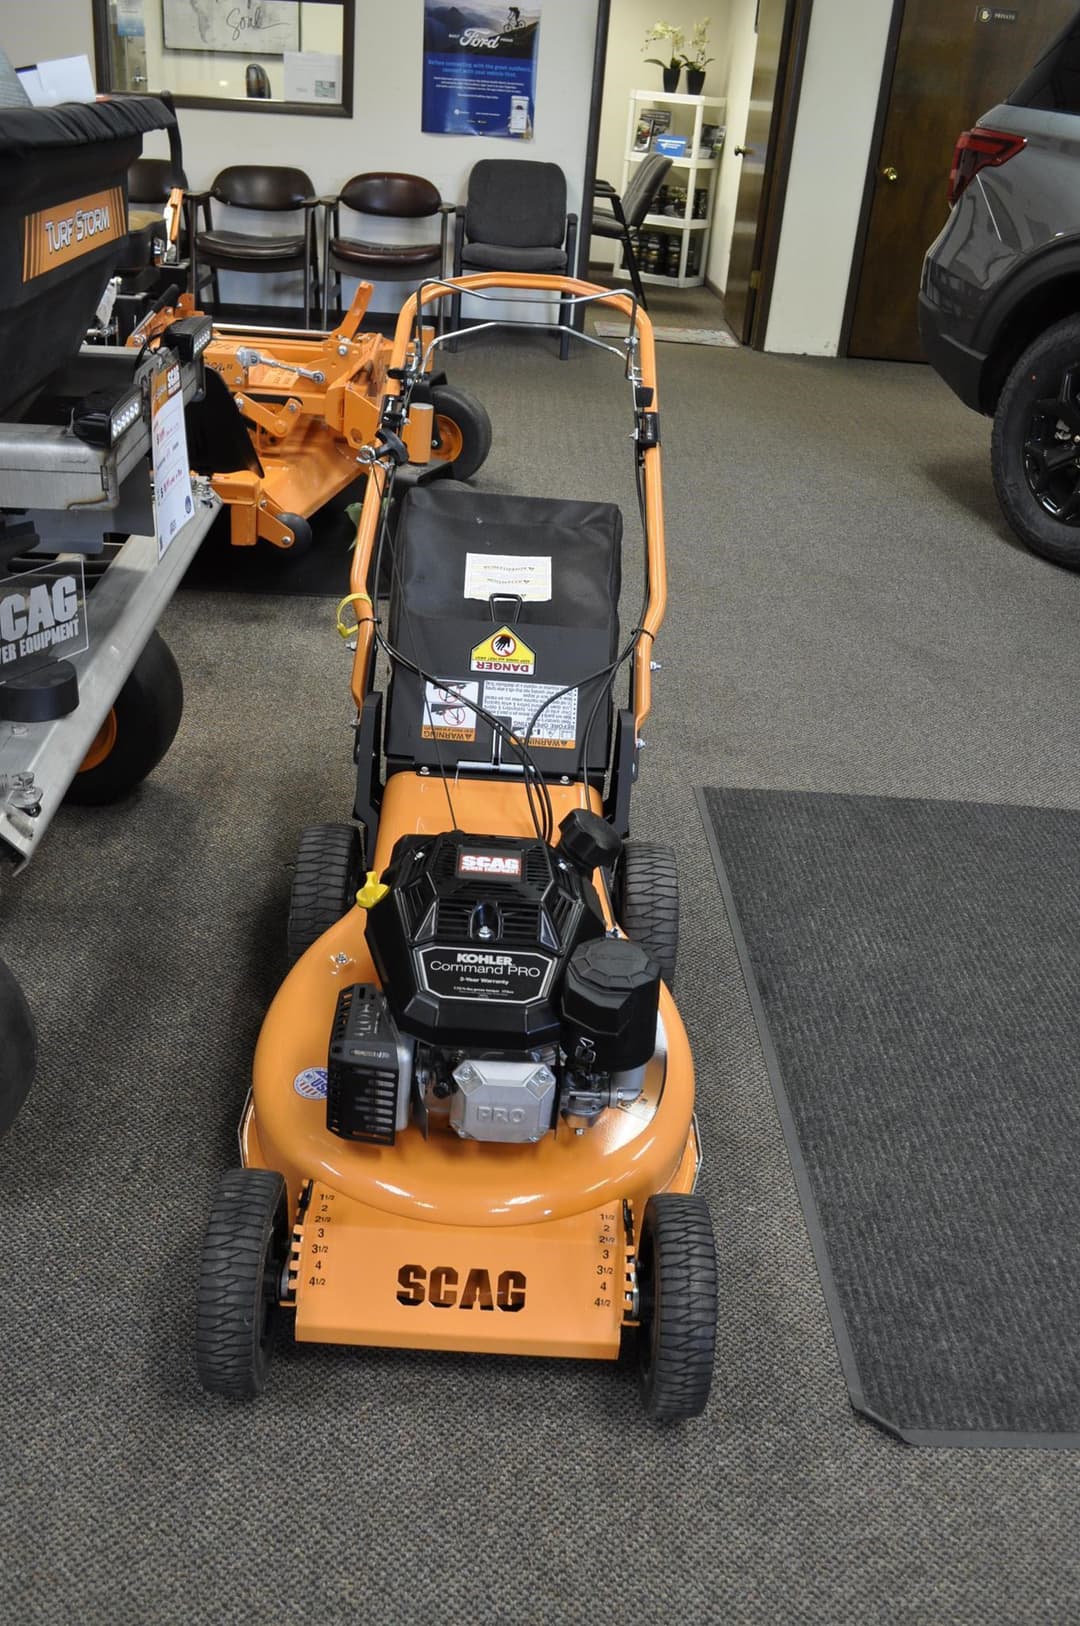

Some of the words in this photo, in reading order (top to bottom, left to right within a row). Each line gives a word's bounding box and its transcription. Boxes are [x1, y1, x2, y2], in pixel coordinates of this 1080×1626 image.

[459, 27, 501, 49] Ford
[45, 218, 74, 255] TURF
[75, 205, 110, 242] STORM
[20, 618, 79, 657] EQUIPMENT
[476, 661, 529, 672] DANGER
[462, 855, 520, 871] SCAG
[456, 953, 513, 966] KOHLER
[430, 961, 504, 975] Command
[507, 966, 541, 978] PRO
[476, 1105, 526, 1124] PRO
[321, 1204, 328, 1212] 2
[317, 1227, 325, 1238] 3
[604, 1224, 610, 1232] 2
[603, 1249, 610, 1260] 3
[315, 1260, 322, 1270] 4
[396, 1263, 527, 1313] SCAG
[600, 1281, 607, 1291] 4
